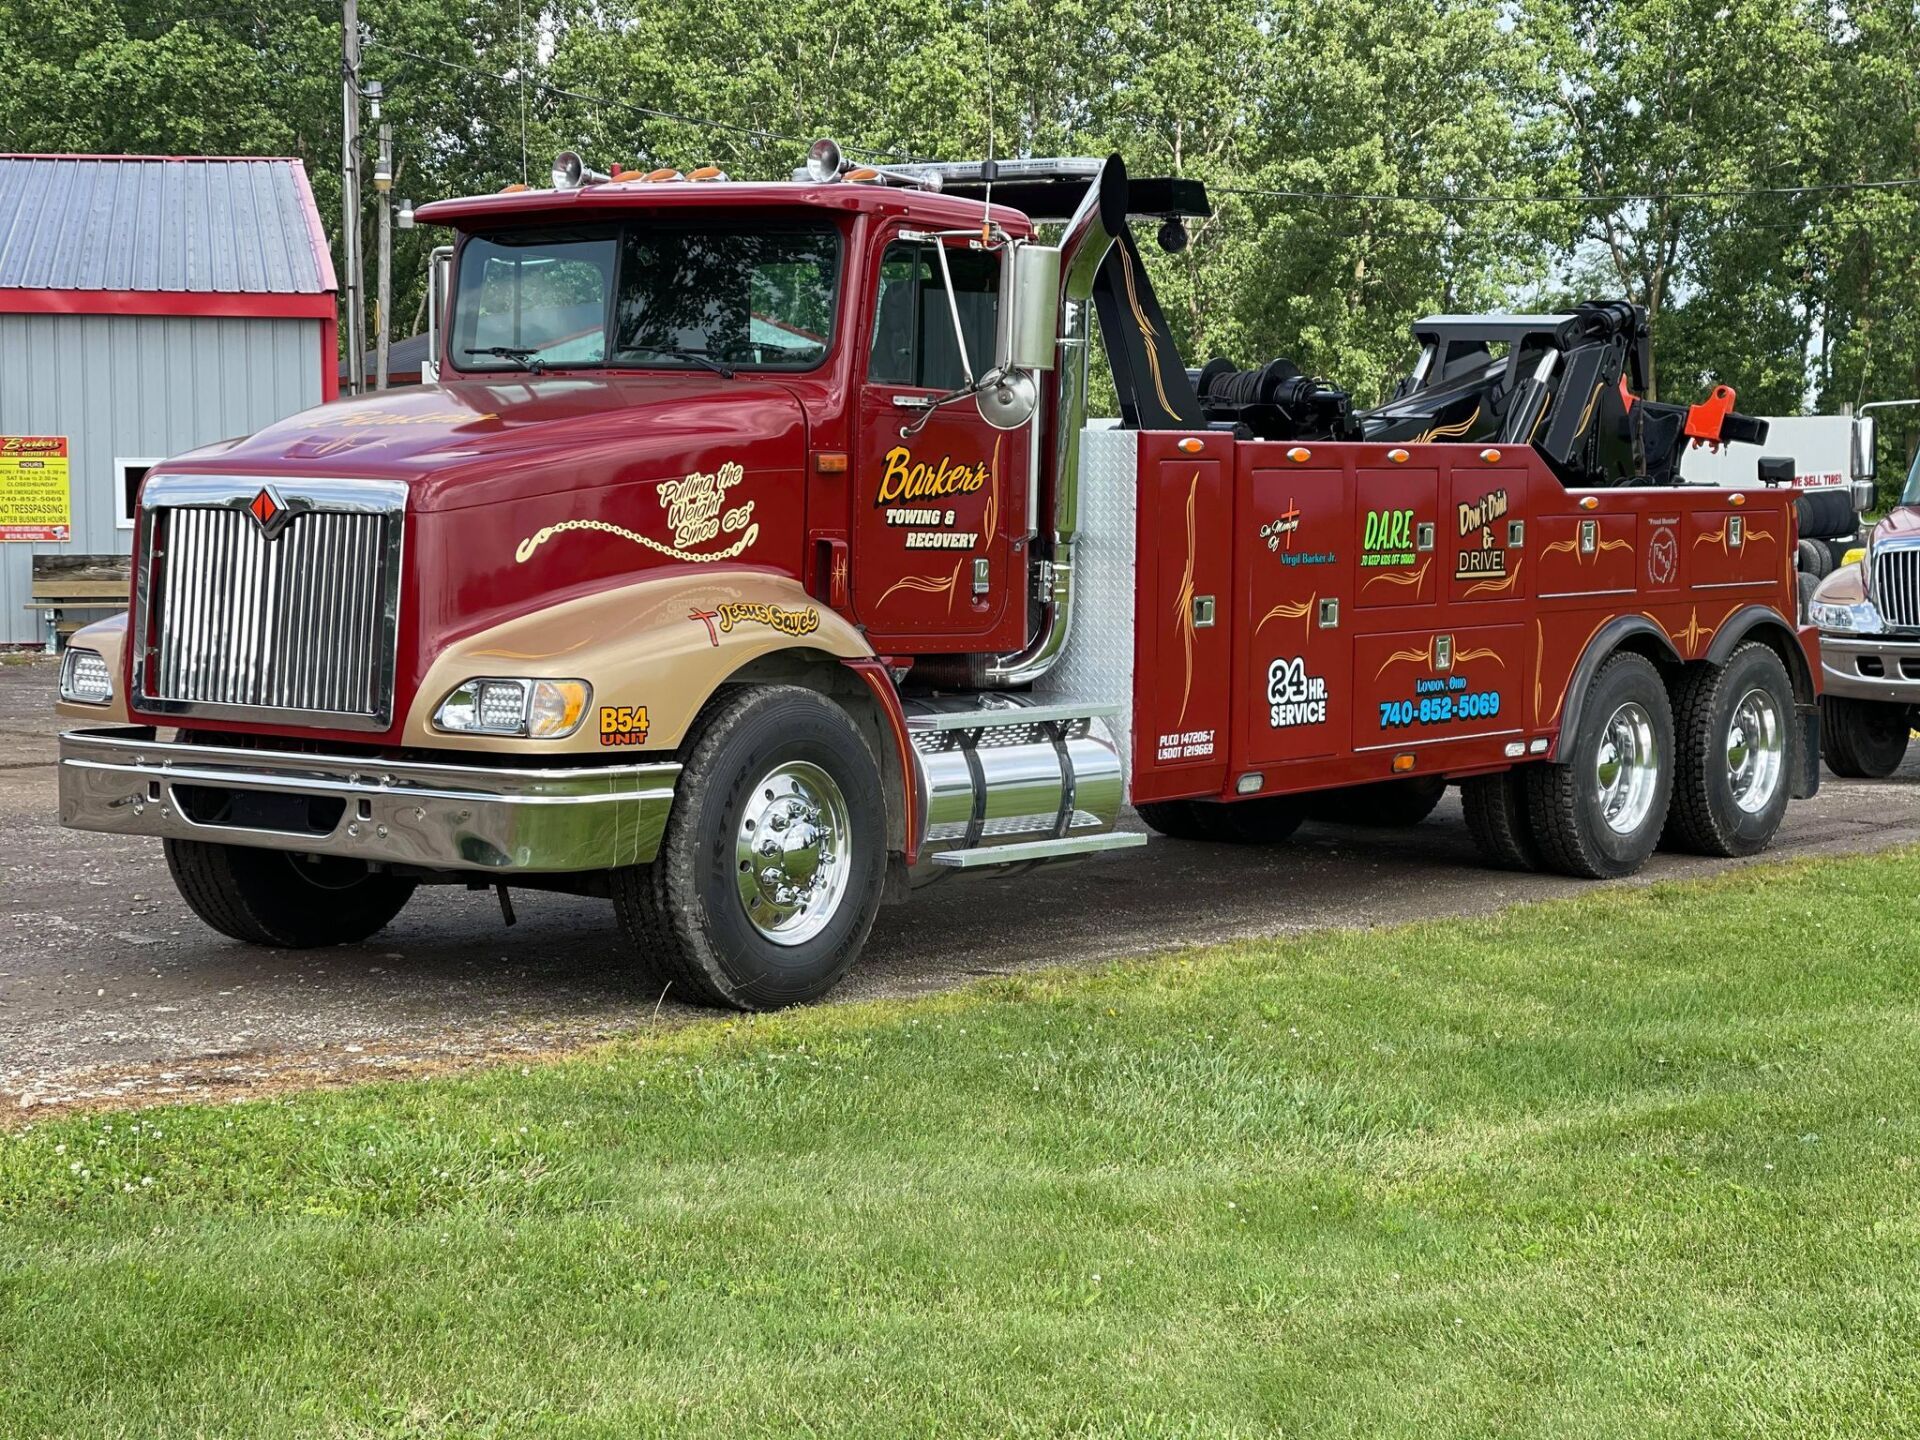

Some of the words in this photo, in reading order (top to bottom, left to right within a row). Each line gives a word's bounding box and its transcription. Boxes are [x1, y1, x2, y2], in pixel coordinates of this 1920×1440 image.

[717, 461, 744, 490] the
[876, 446, 990, 506] Barker's
[1804, 475, 1822, 487] SELL
[1823, 473, 1843, 485] TIRES
[0, 504, 9, 514] NO
[11, 504, 63, 514] TRESSPASSING
[668, 489, 725, 530] Weight
[885, 508, 942, 525] TOWING
[944, 510, 956, 526] &
[1458, 498, 1487, 537] Don't
[674, 518, 720, 549] Since
[905, 532, 979, 549] RECOVERY
[1364, 509, 1415, 551] D.A.R.E.
[1482, 525, 1495, 550] &
[1281, 553, 1300, 566] Virgil
[1302, 552, 1327, 564] Barker
[1391, 554, 1401, 565] OFF
[1459, 550, 1506, 571] DRIVE!
[717, 603, 771, 632] Jesus
[767, 605, 820, 636] Saves
[1268, 657, 1308, 704] 24
[1308, 677, 1329, 700] HR.
[600, 706, 649, 733] B54
[1270, 701, 1326, 728] SERVICE
[1380, 692, 1500, 727] 740-852-5069
[600, 732, 648, 746] UNIT
[1158, 746, 1182, 760] USDOT
[1183, 743, 1214, 757] 1219669
[1160, 734, 1179, 747] PUCO
[1180, 730, 1215, 745] 147206-T
